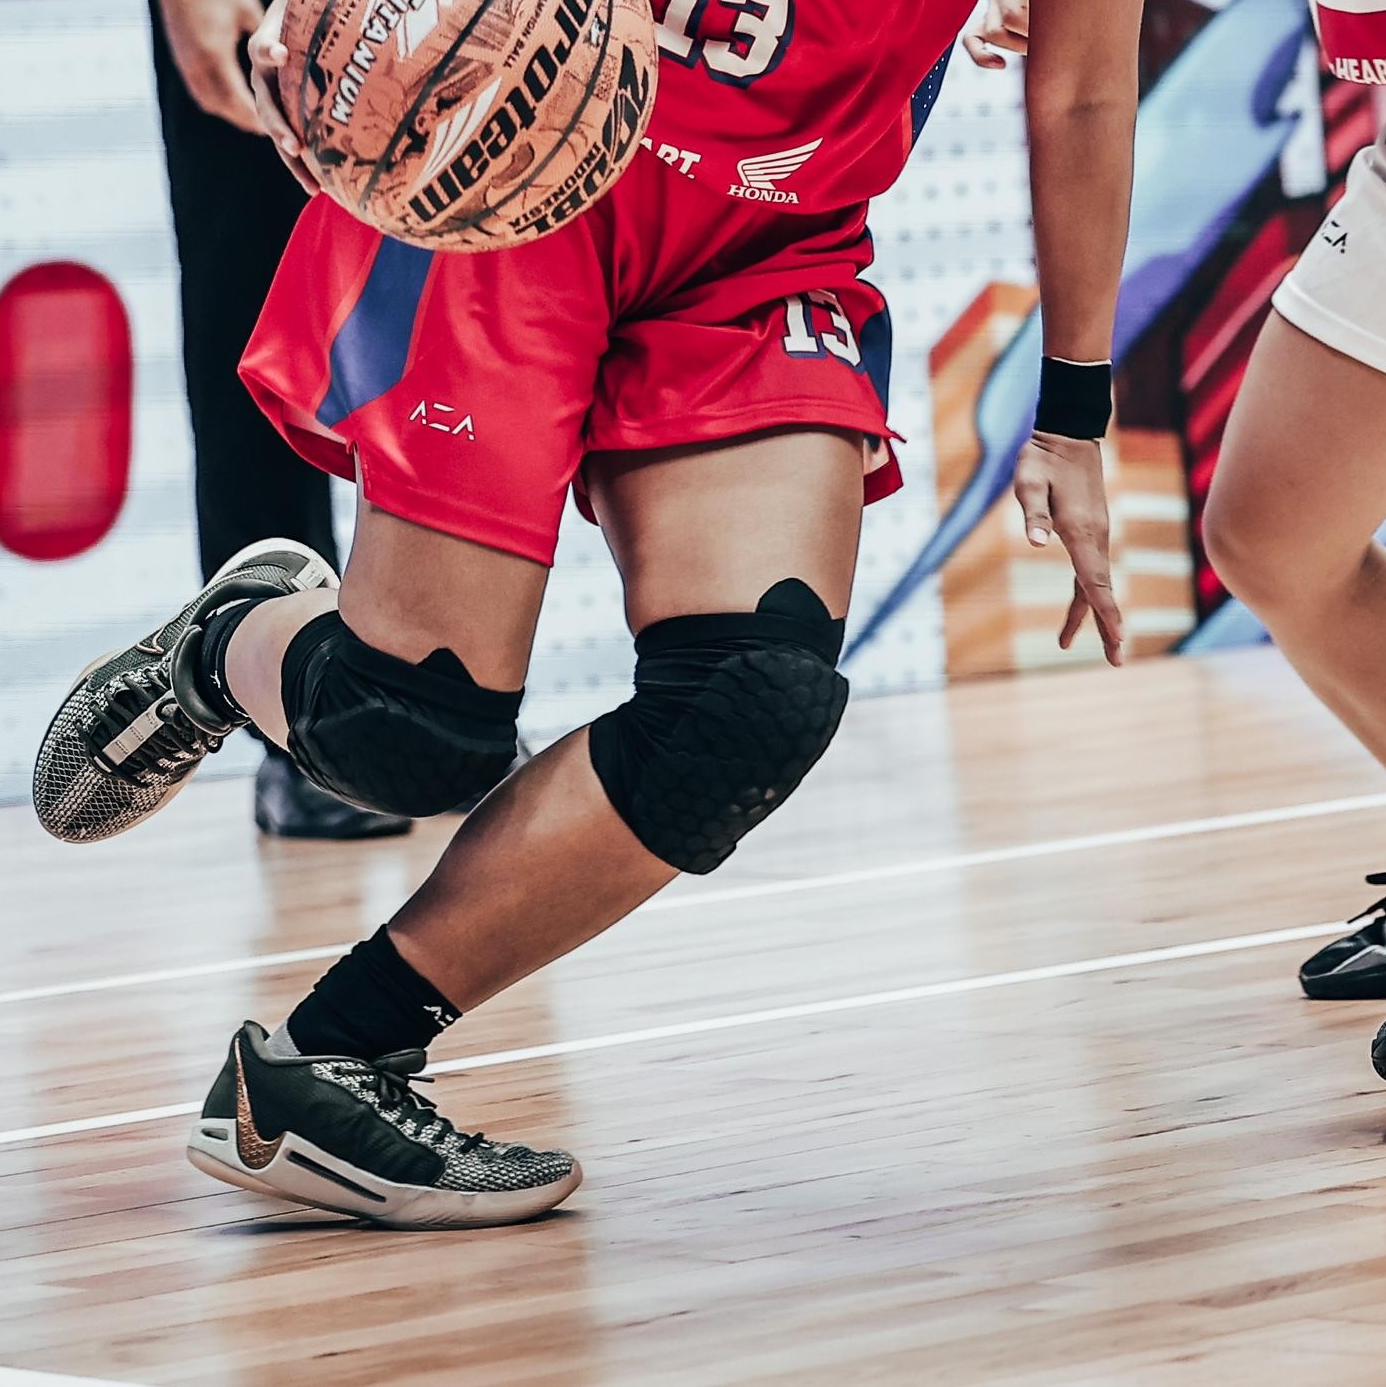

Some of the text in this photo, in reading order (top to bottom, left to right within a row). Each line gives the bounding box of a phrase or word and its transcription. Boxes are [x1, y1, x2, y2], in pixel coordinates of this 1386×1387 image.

[502, 38, 525, 69] BALL
[507, 141, 602, 229] INDONESIA
[515, 150, 612, 235] DBL
[726, 183, 800, 205] HONDA
[782, 288, 864, 373] 13
